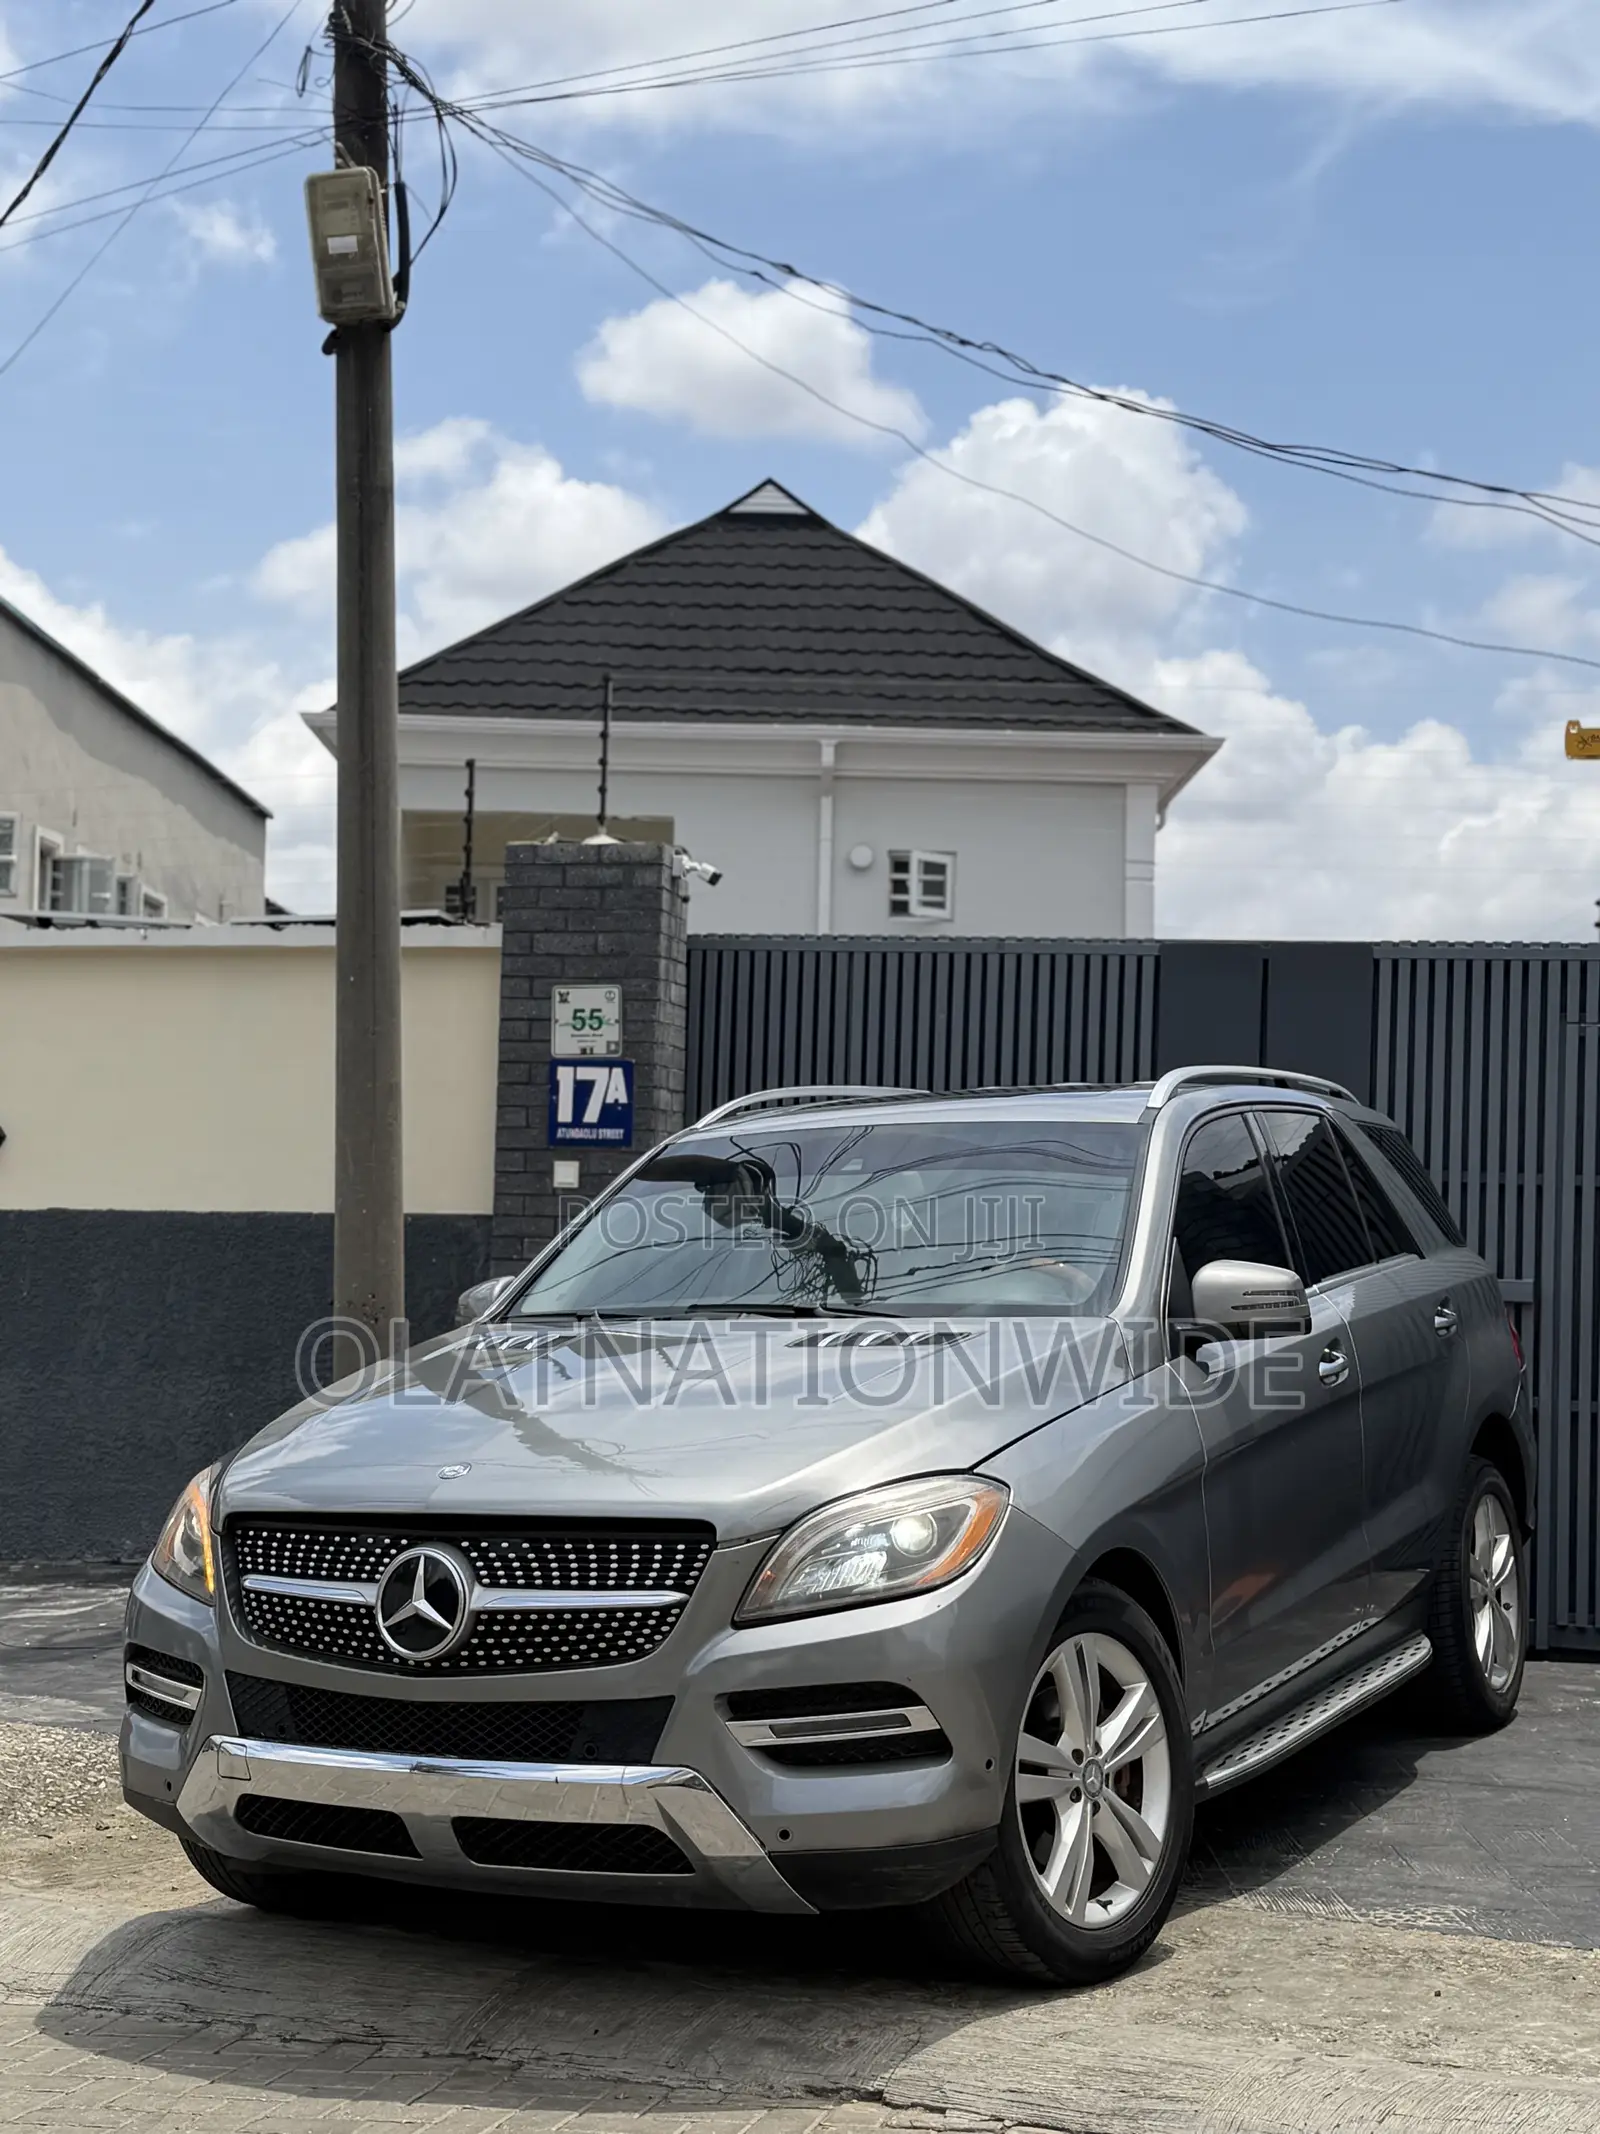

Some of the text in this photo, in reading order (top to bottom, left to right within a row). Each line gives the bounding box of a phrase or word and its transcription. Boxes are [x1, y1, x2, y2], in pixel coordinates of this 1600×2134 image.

[571, 1007, 604, 1031] 55
[556, 1066, 628, 1123] 17A
[598, 1128, 625, 1140] STREET
